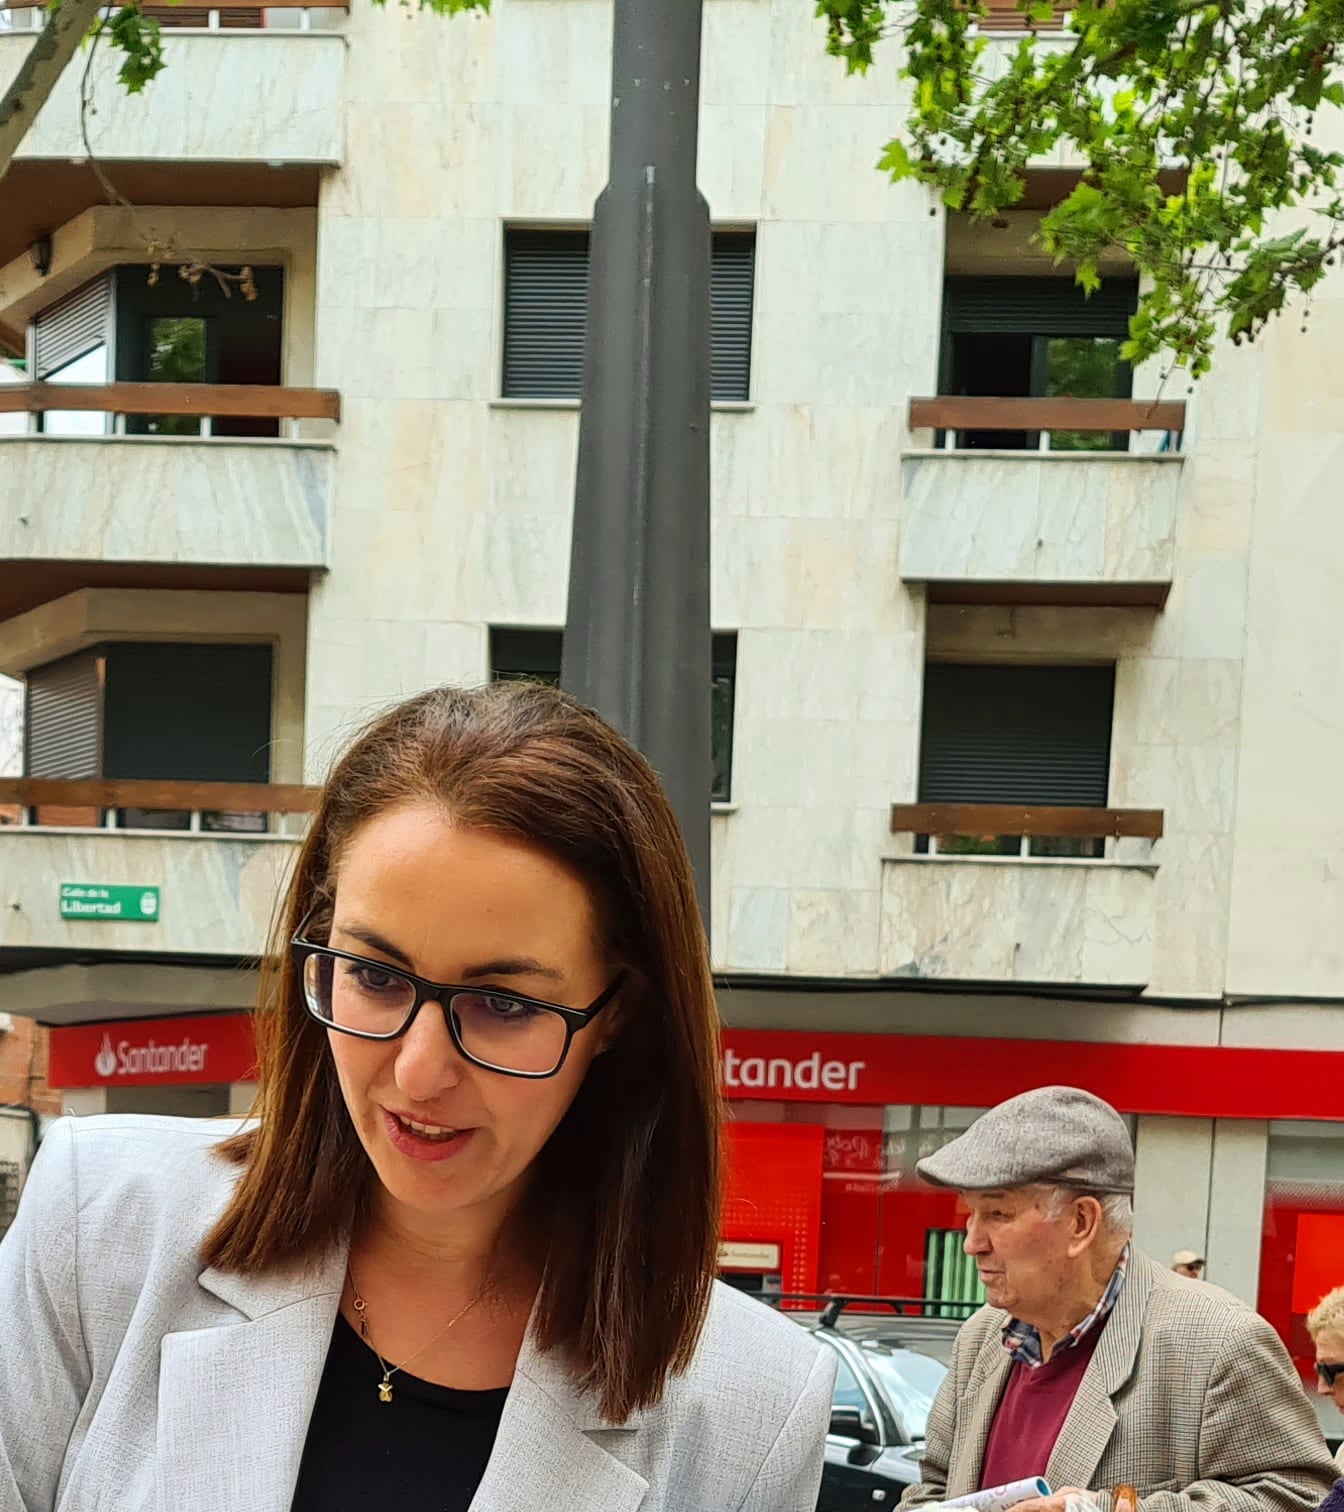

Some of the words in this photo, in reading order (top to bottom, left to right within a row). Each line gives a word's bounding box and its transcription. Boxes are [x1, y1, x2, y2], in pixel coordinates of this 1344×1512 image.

[61, 900, 122, 914] Libertad
[116, 1037, 208, 1075] Santander
[724, 1049, 866, 1091] tander
